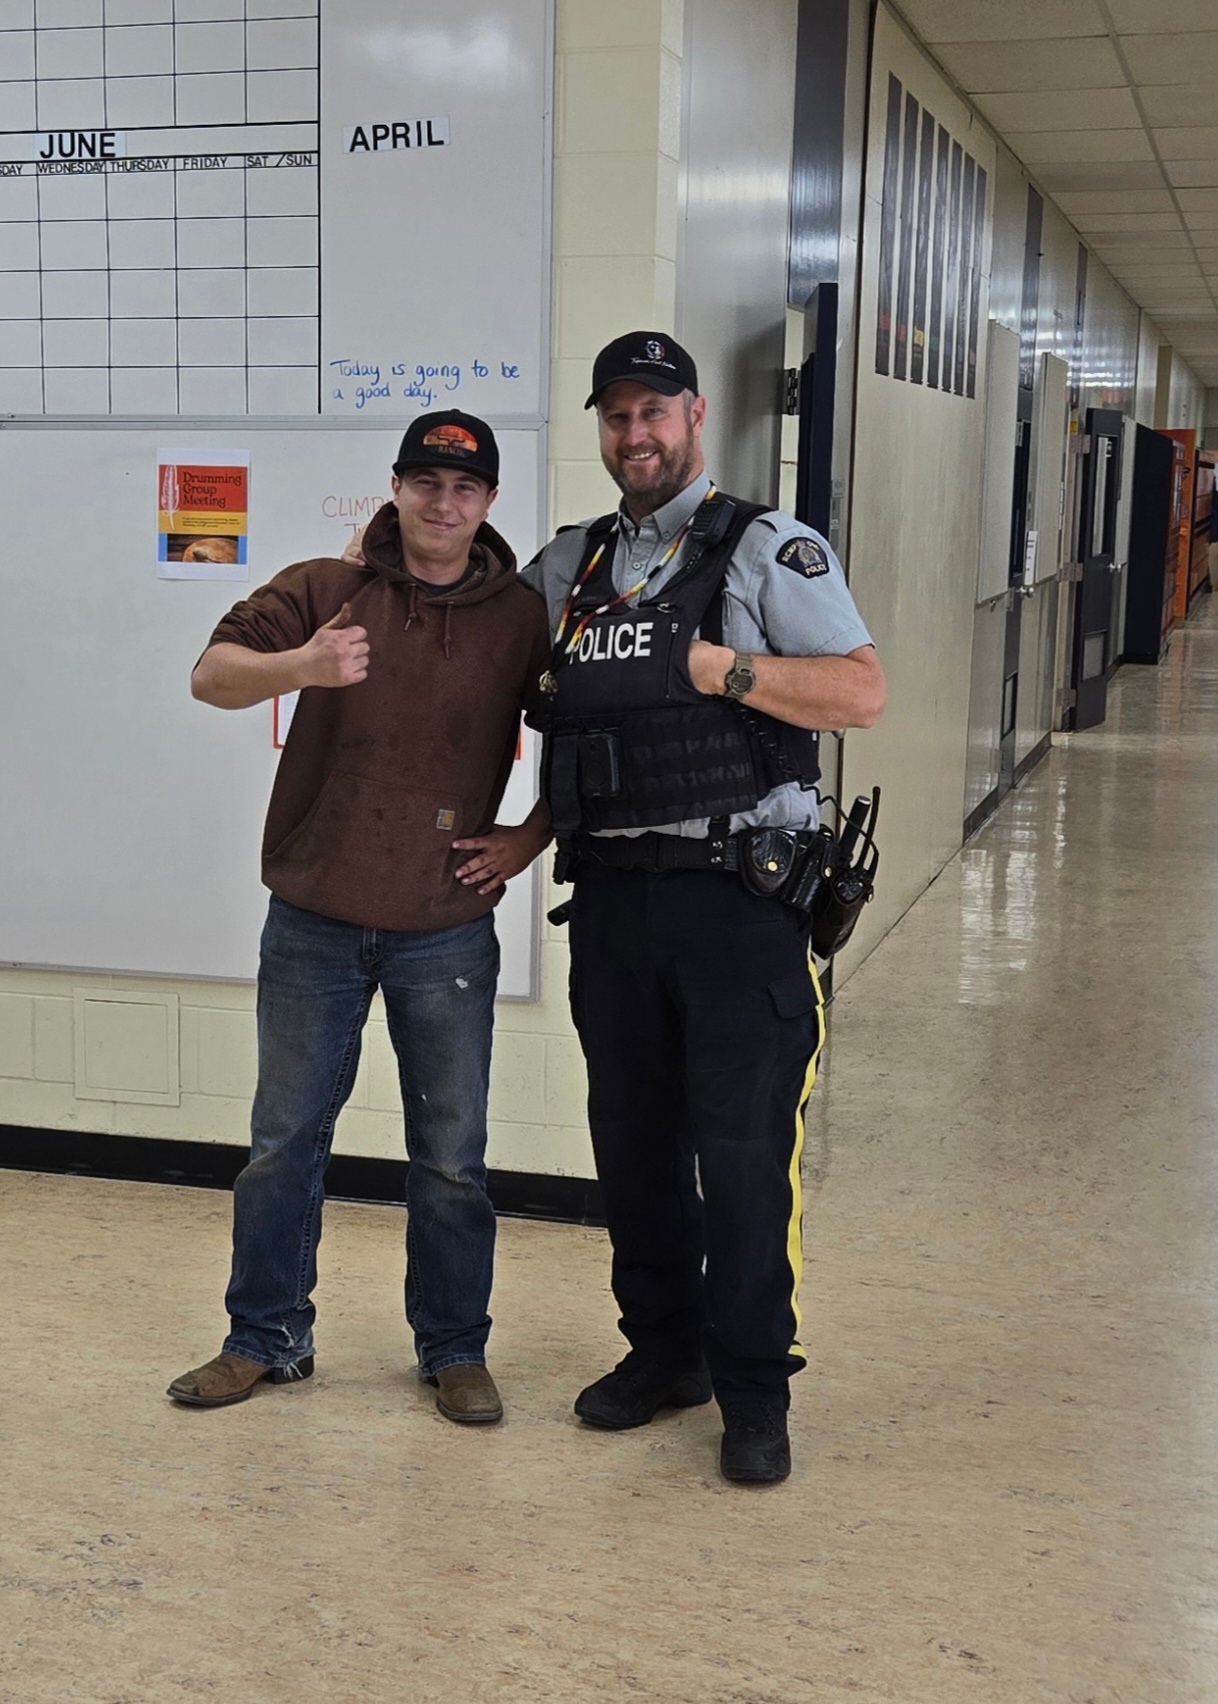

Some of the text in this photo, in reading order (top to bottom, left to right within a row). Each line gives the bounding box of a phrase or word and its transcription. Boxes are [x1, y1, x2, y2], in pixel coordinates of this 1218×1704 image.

[39, 132, 116, 159] JUNE
[349, 120, 445, 152] APRIL
[38, 161, 105, 174] WEDNESDAY
[110, 158, 170, 172] THURSDAY
[183, 157, 228, 169] FRIDAY
[247, 155, 269, 168] SAT
[330, 359, 521, 390] Today is going to be
[332, 385, 438, 408] a good day.
[183, 472, 242, 486] Drumming
[182, 482, 217, 498] Group
[183, 495, 226, 508] Meeting
